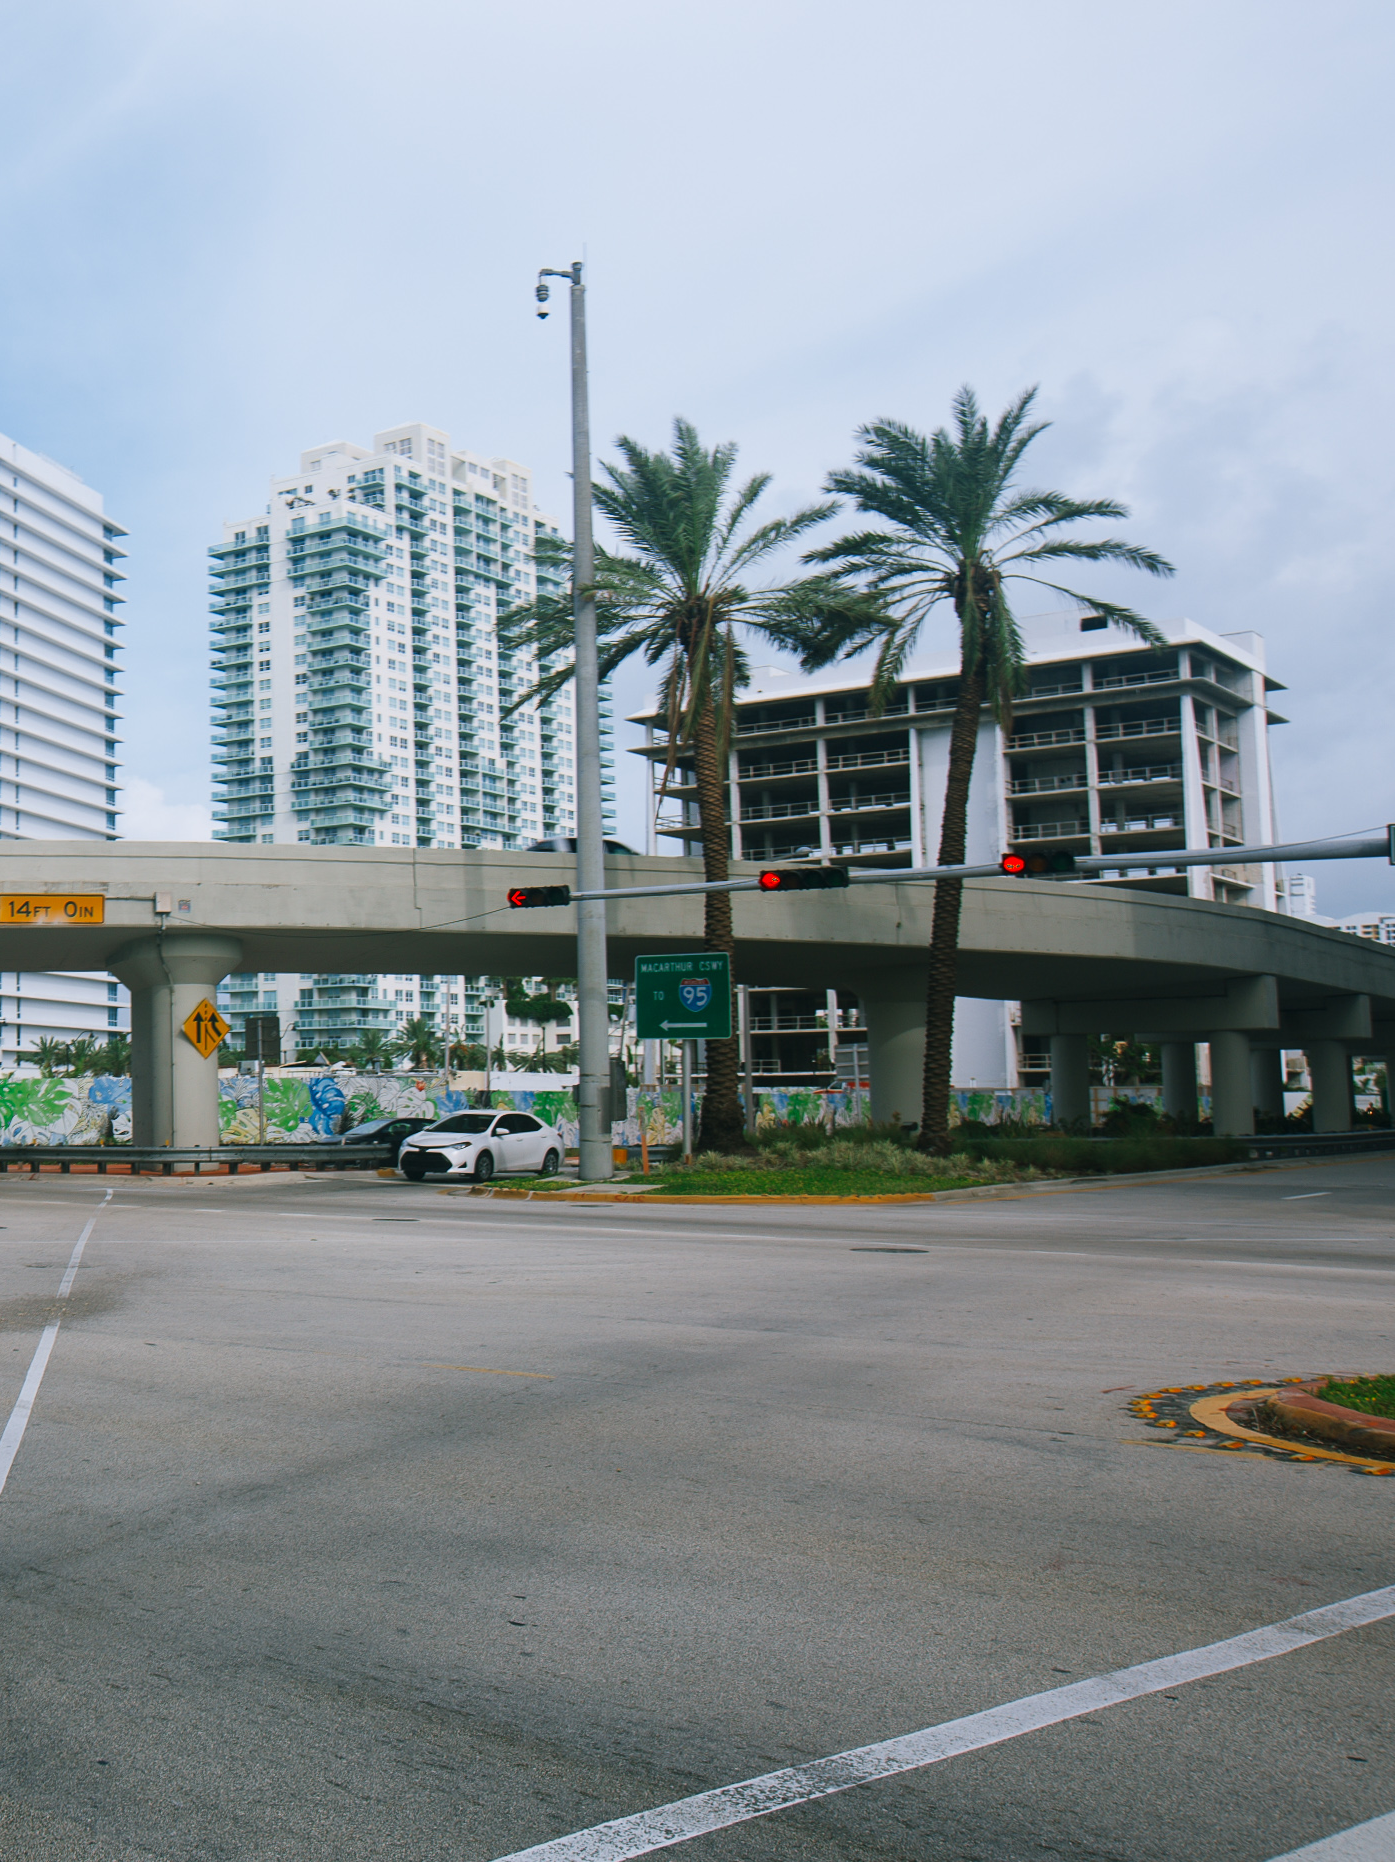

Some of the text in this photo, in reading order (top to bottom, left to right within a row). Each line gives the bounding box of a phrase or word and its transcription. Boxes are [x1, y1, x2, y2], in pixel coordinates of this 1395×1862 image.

[8, 900, 51, 917] 14FT
[640, 960, 724, 973] MACARTHUR CSWY
[652, 990, 665, 1001] TO
[682, 986, 708, 1007] 95
